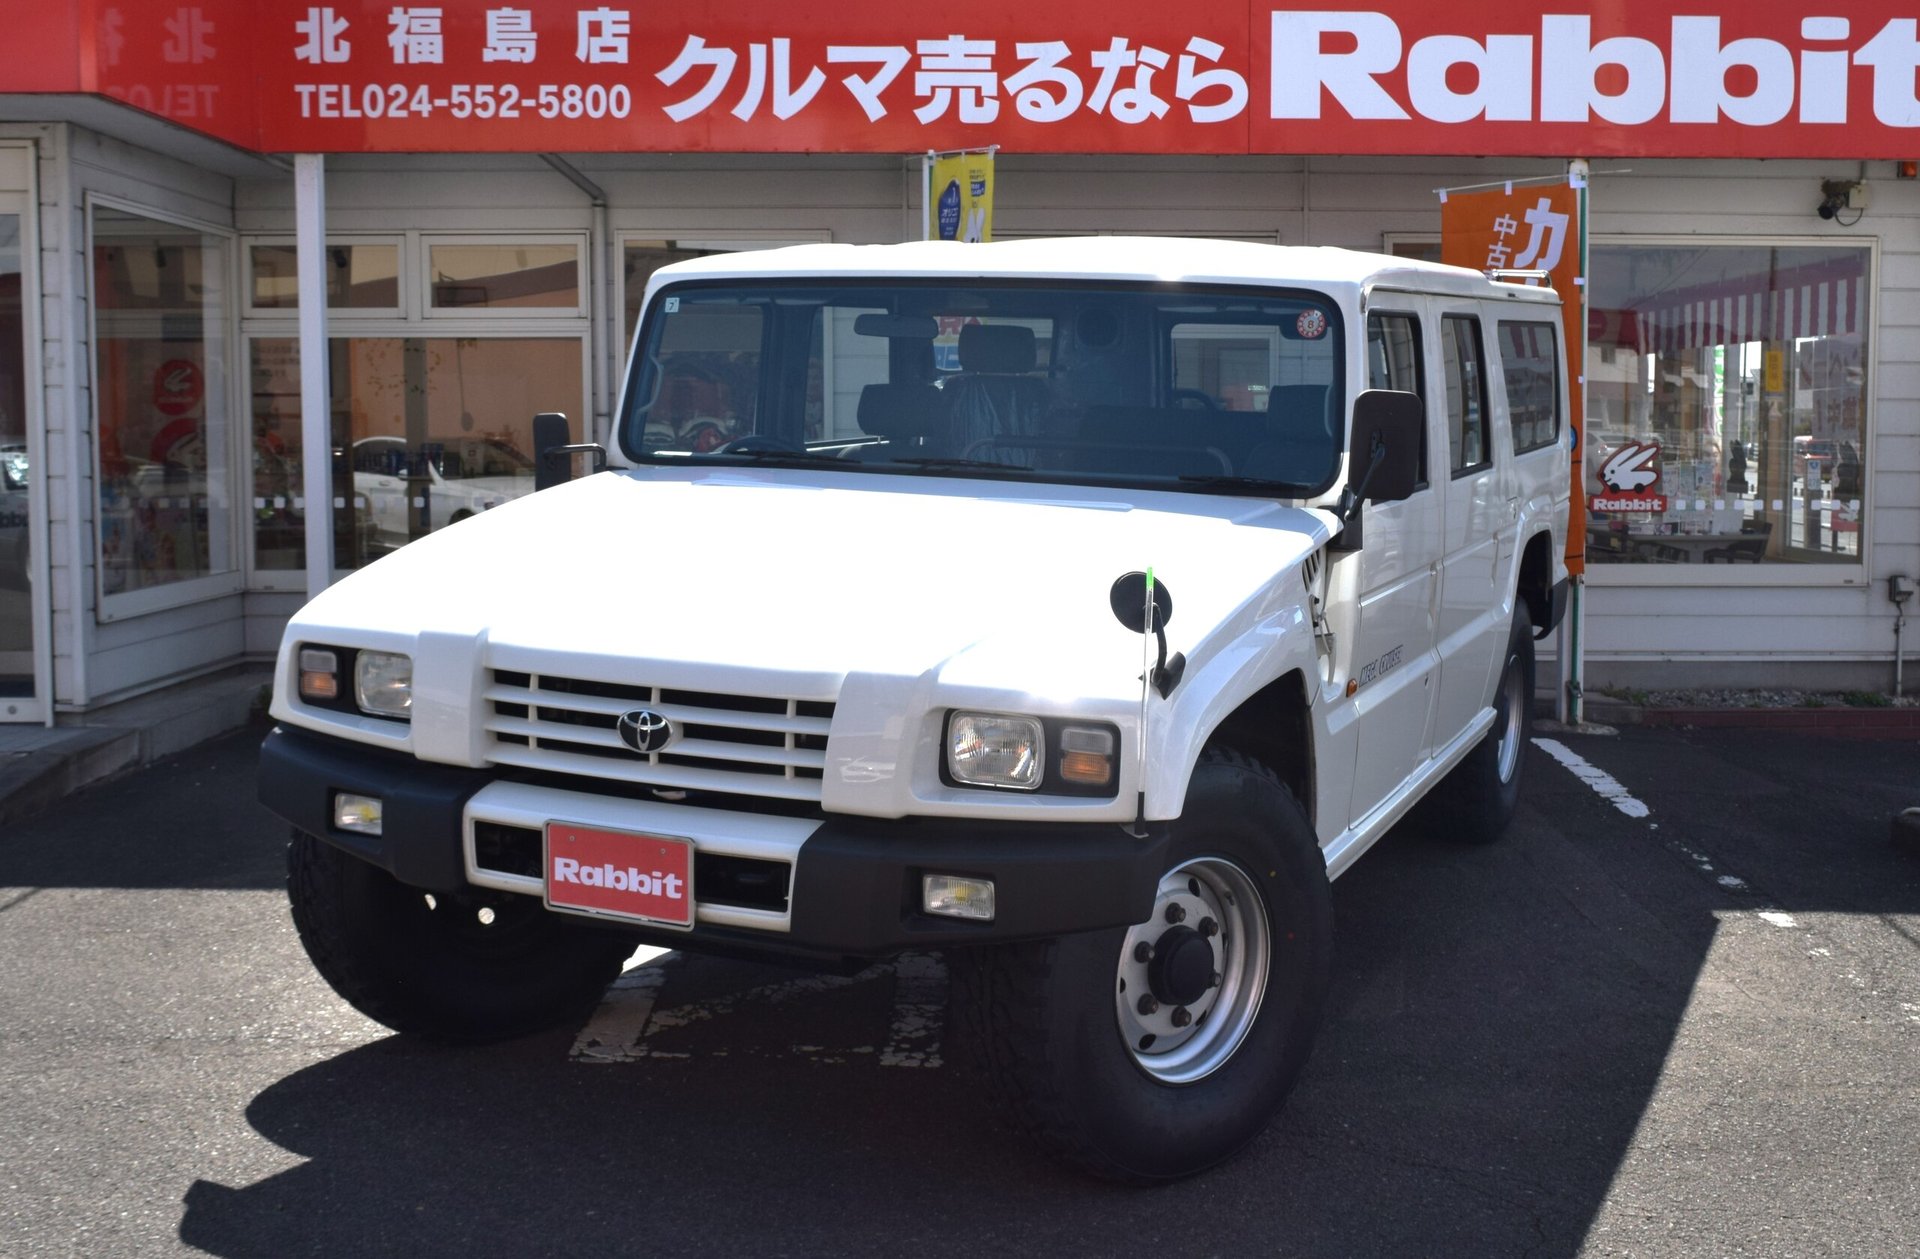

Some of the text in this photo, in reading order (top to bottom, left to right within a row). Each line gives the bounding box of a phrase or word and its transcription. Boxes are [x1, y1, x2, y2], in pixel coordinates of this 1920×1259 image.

[294, 7, 631, 64] 北福島店
[655, 35, 1249, 125] クルマ売るなら
[1271, 11, 1920, 128] Rabbit
[294, 84, 632, 119] TEL024-552-5800
[1593, 498, 1662, 512] Rabbit
[554, 857, 683, 900] Rabbit
